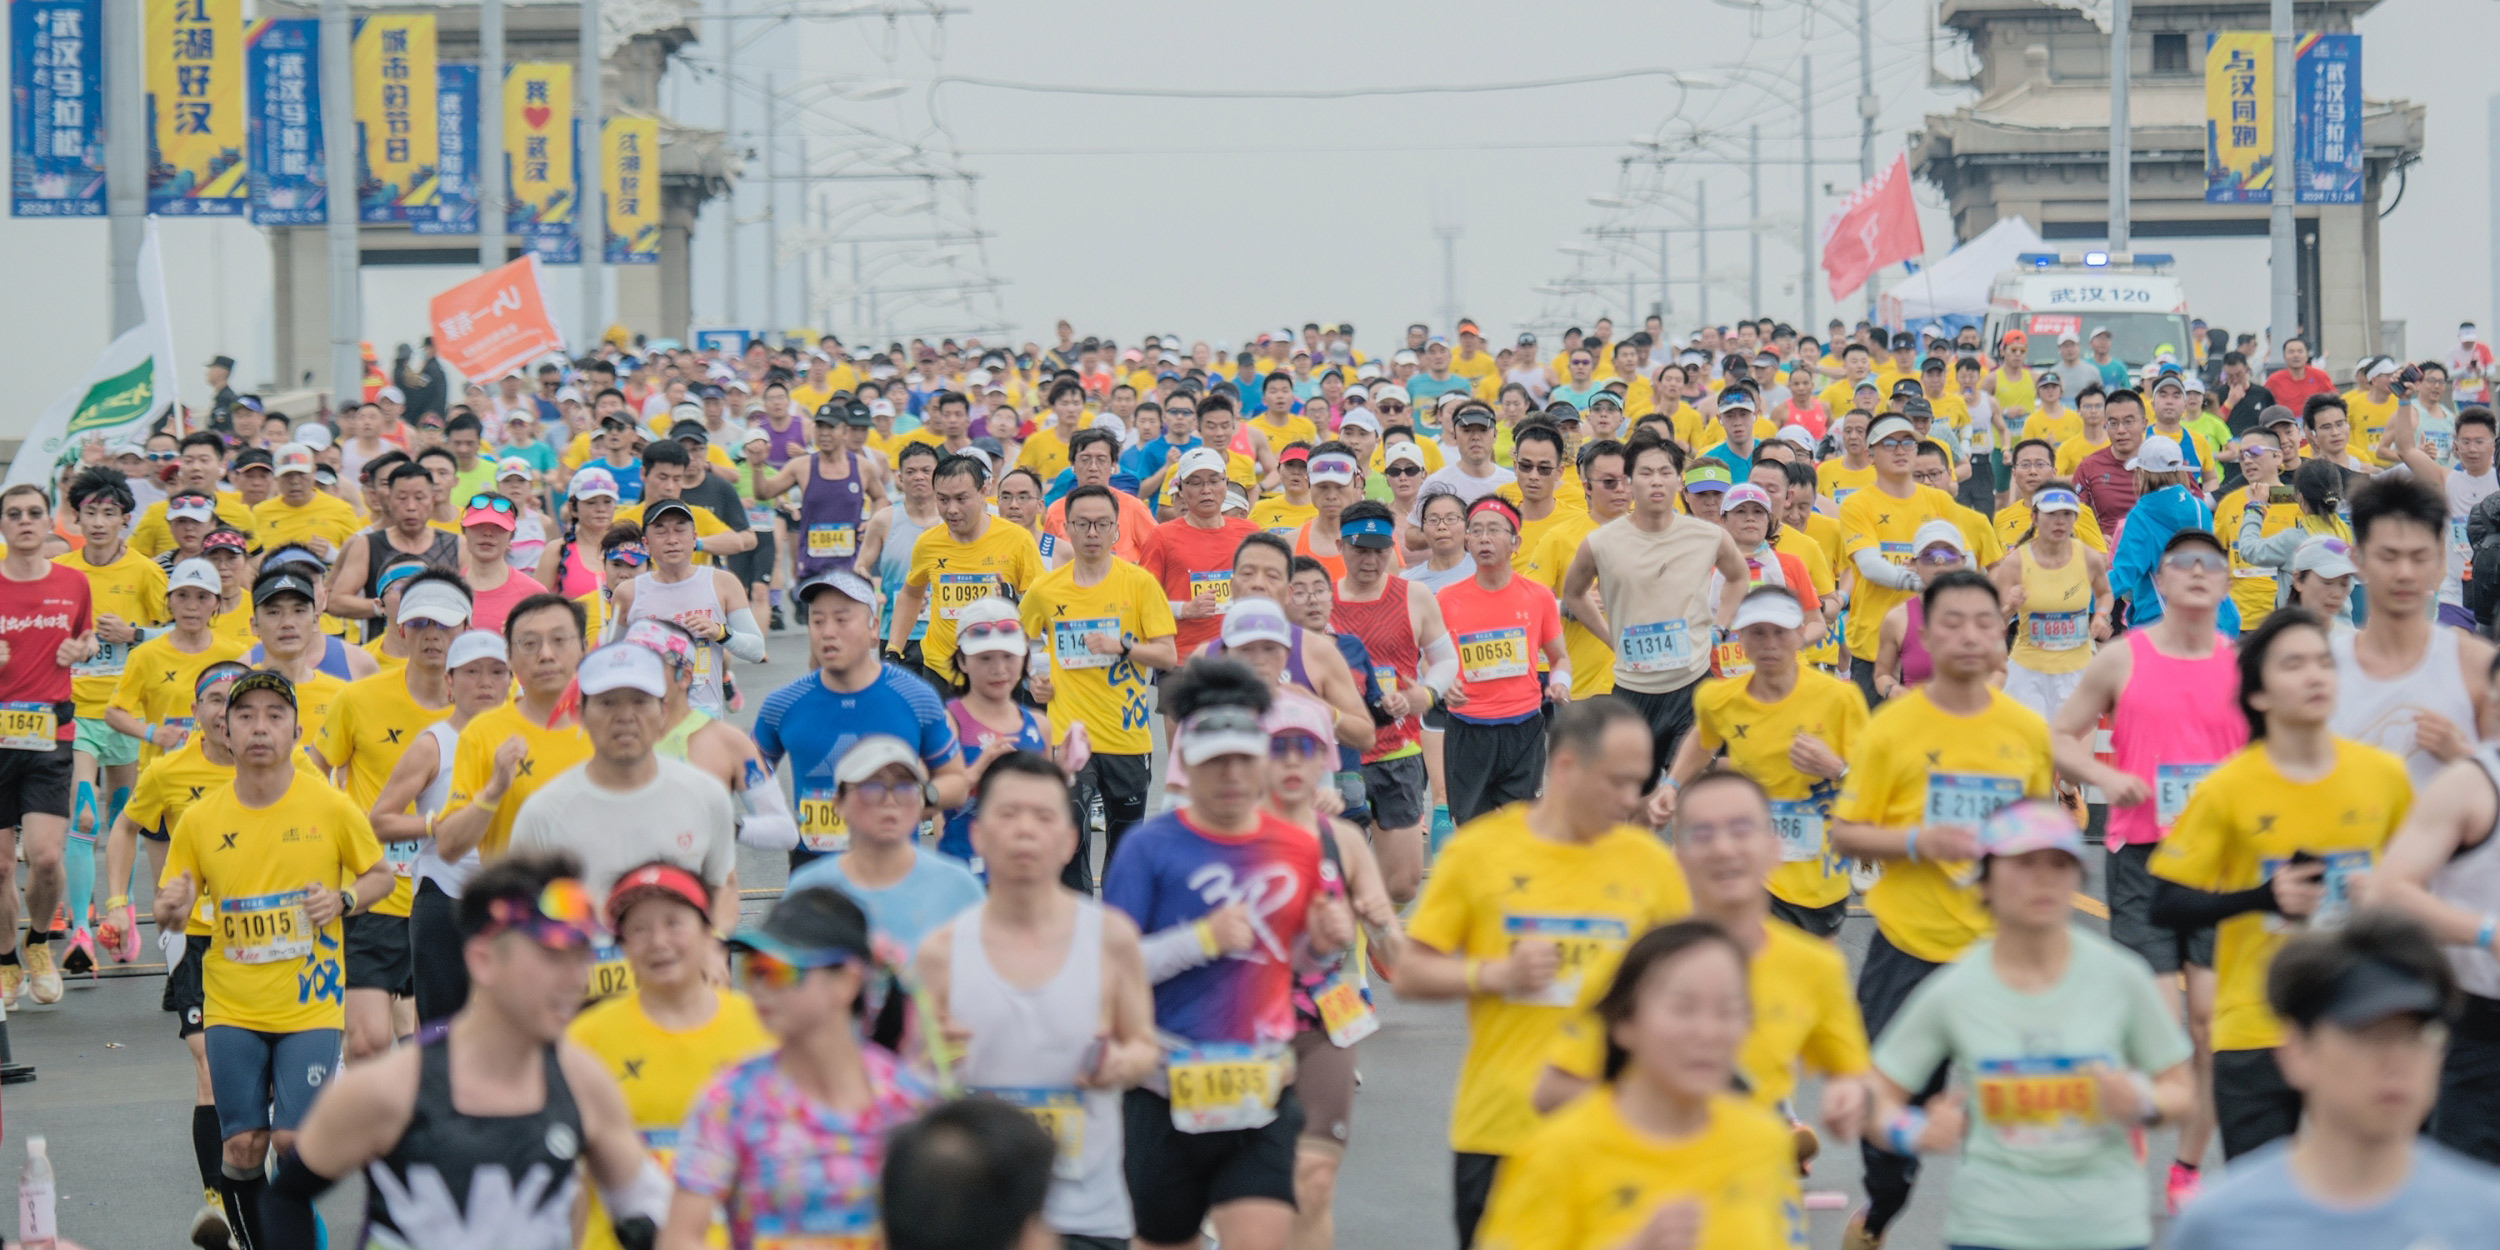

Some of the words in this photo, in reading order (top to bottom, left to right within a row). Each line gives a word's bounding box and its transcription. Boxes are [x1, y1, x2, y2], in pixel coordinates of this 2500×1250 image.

[173, 0, 214, 136] 江湖好汉
[51, 8, 84, 157] 武汉马拉松
[381, 28, 410, 163] 城市的节日
[2223, 50, 2257, 148] 与汉同跑
[2324, 62, 2346, 163] 武汉马拉松
[279, 52, 309, 176] 武汉马拉松
[524, 135, 550, 183] 武汉
[942, 585, 950, 601] C
[955, 585, 988, 602] 0932
[1057, 634, 1065, 650] E
[1070, 633, 1086, 651] 14
[1462, 647, 1472, 664] D
[1475, 640, 1513, 662] 0653
[1623, 639, 1632, 656] E
[1636, 635, 1673, 655] 1314
[8, 713, 44, 731] 1647
[1931, 792, 1942, 817] E
[2163, 782, 2173, 804] E
[805, 805, 813, 826] D
[820, 804, 841, 825] 08
[224, 916, 235, 940] C
[240, 911, 292, 940] 1015
[600, 966, 628, 994] 02
